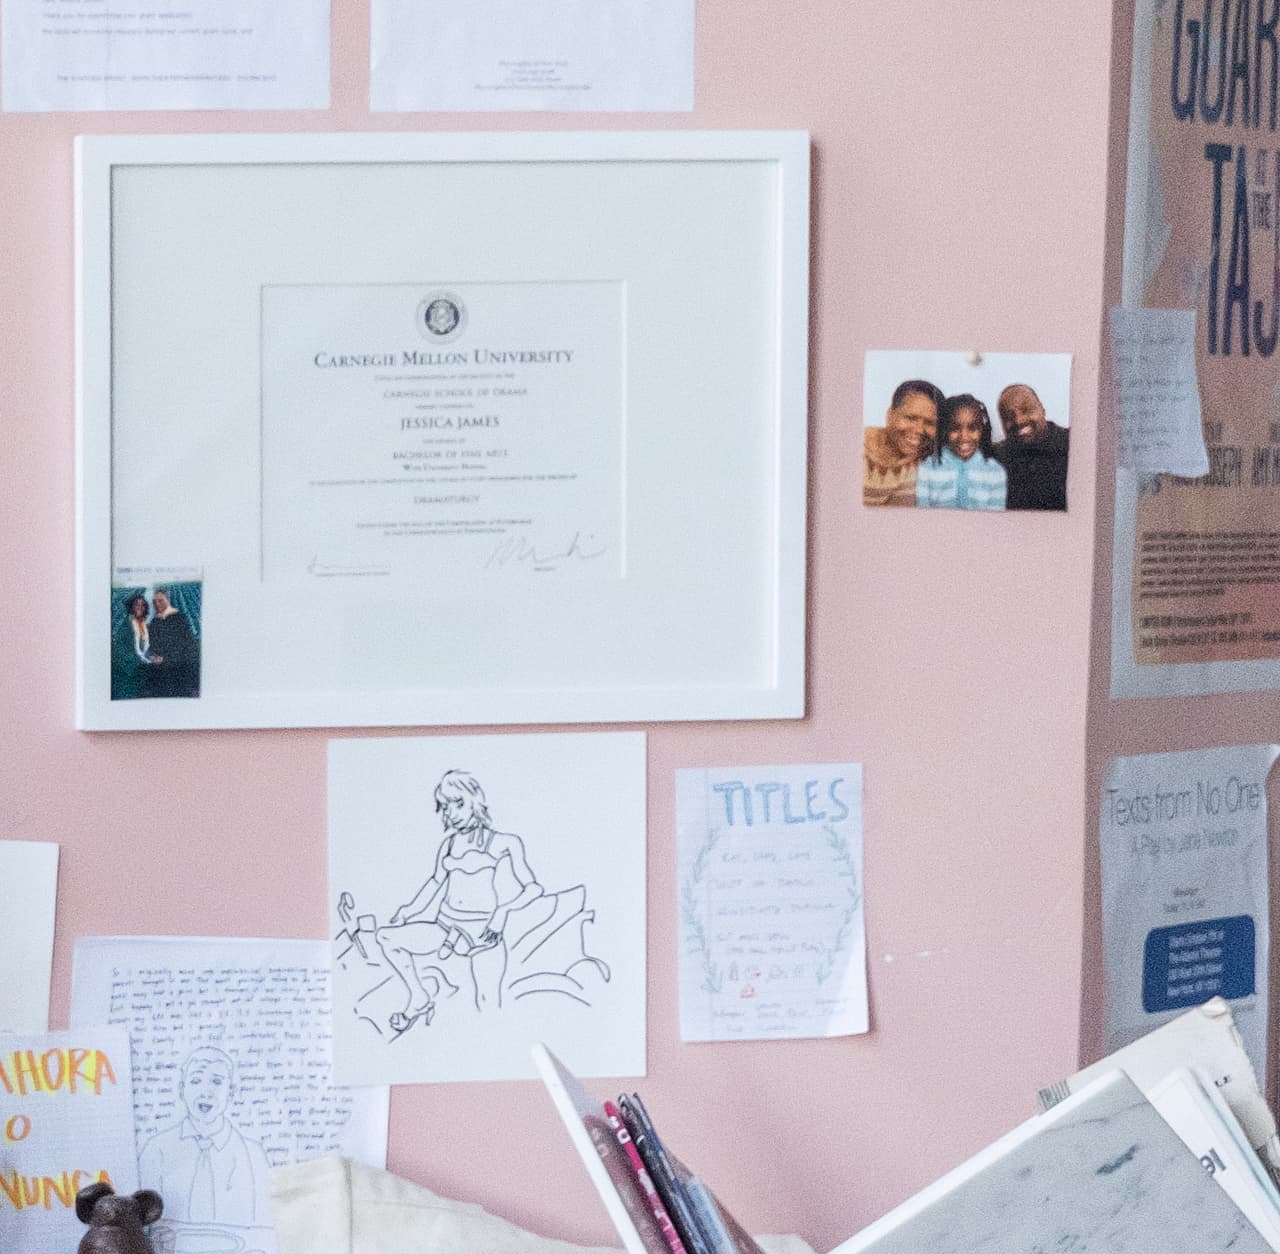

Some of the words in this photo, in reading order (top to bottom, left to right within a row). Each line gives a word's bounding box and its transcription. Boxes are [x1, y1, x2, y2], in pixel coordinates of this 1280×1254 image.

[313, 350, 395, 369] CARNEGIE
[402, 349, 468, 367] MELLON
[473, 347, 575, 366] UNIVERSITY
[400, 416, 454, 431] JESSICA
[455, 414, 501, 430] JAMES
[711, 777, 850, 827] TITLES
[1106, 787, 1153, 827] Texts
[1154, 782, 1192, 821] from
[1196, 777, 1222, 817] No
[1225, 774, 1262, 815] One
[4, 1113, 33, 1143] O
